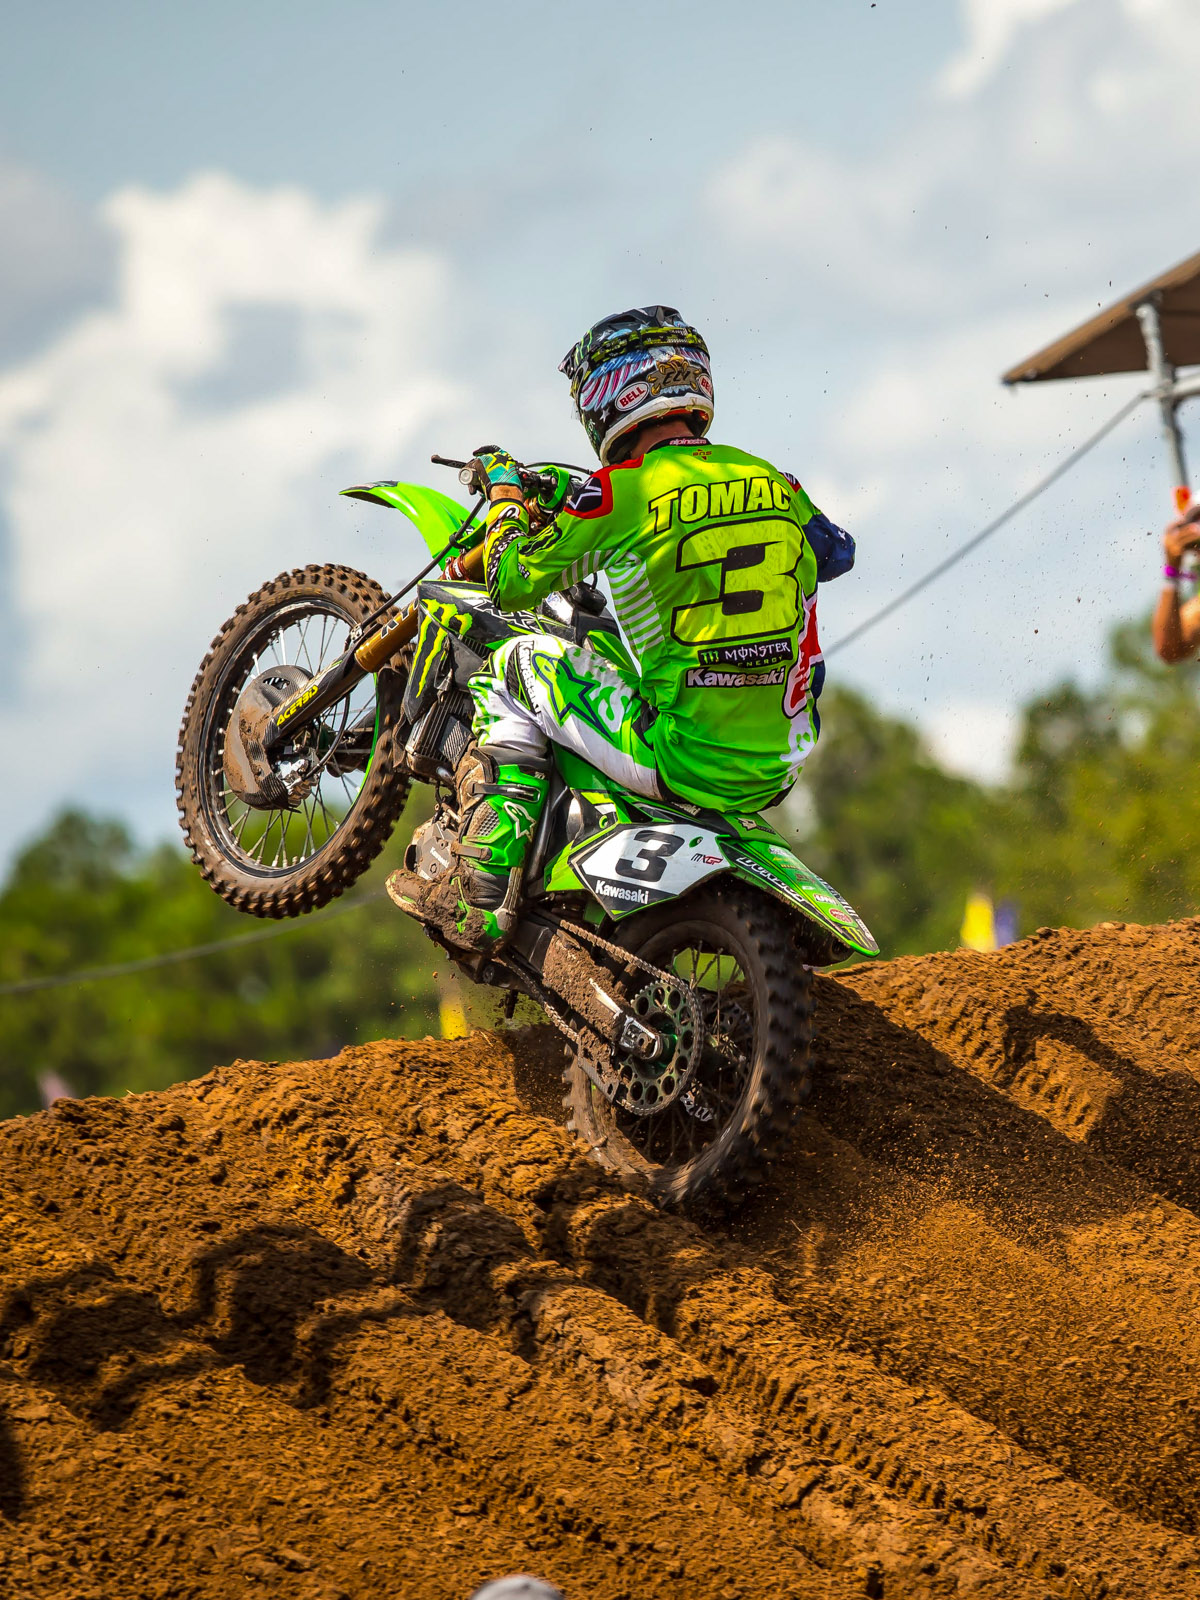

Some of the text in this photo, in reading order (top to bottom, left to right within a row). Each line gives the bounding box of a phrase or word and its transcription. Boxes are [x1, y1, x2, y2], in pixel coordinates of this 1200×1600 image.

[619, 386, 646, 408] BELL
[648, 476, 792, 536] TOMAC
[670, 515, 805, 647] 3
[725, 640, 791, 662] MONSTER
[686, 665, 786, 688] Kawasaki
[615, 830, 686, 883] 3
[595, 879, 649, 905] Kawasaki
